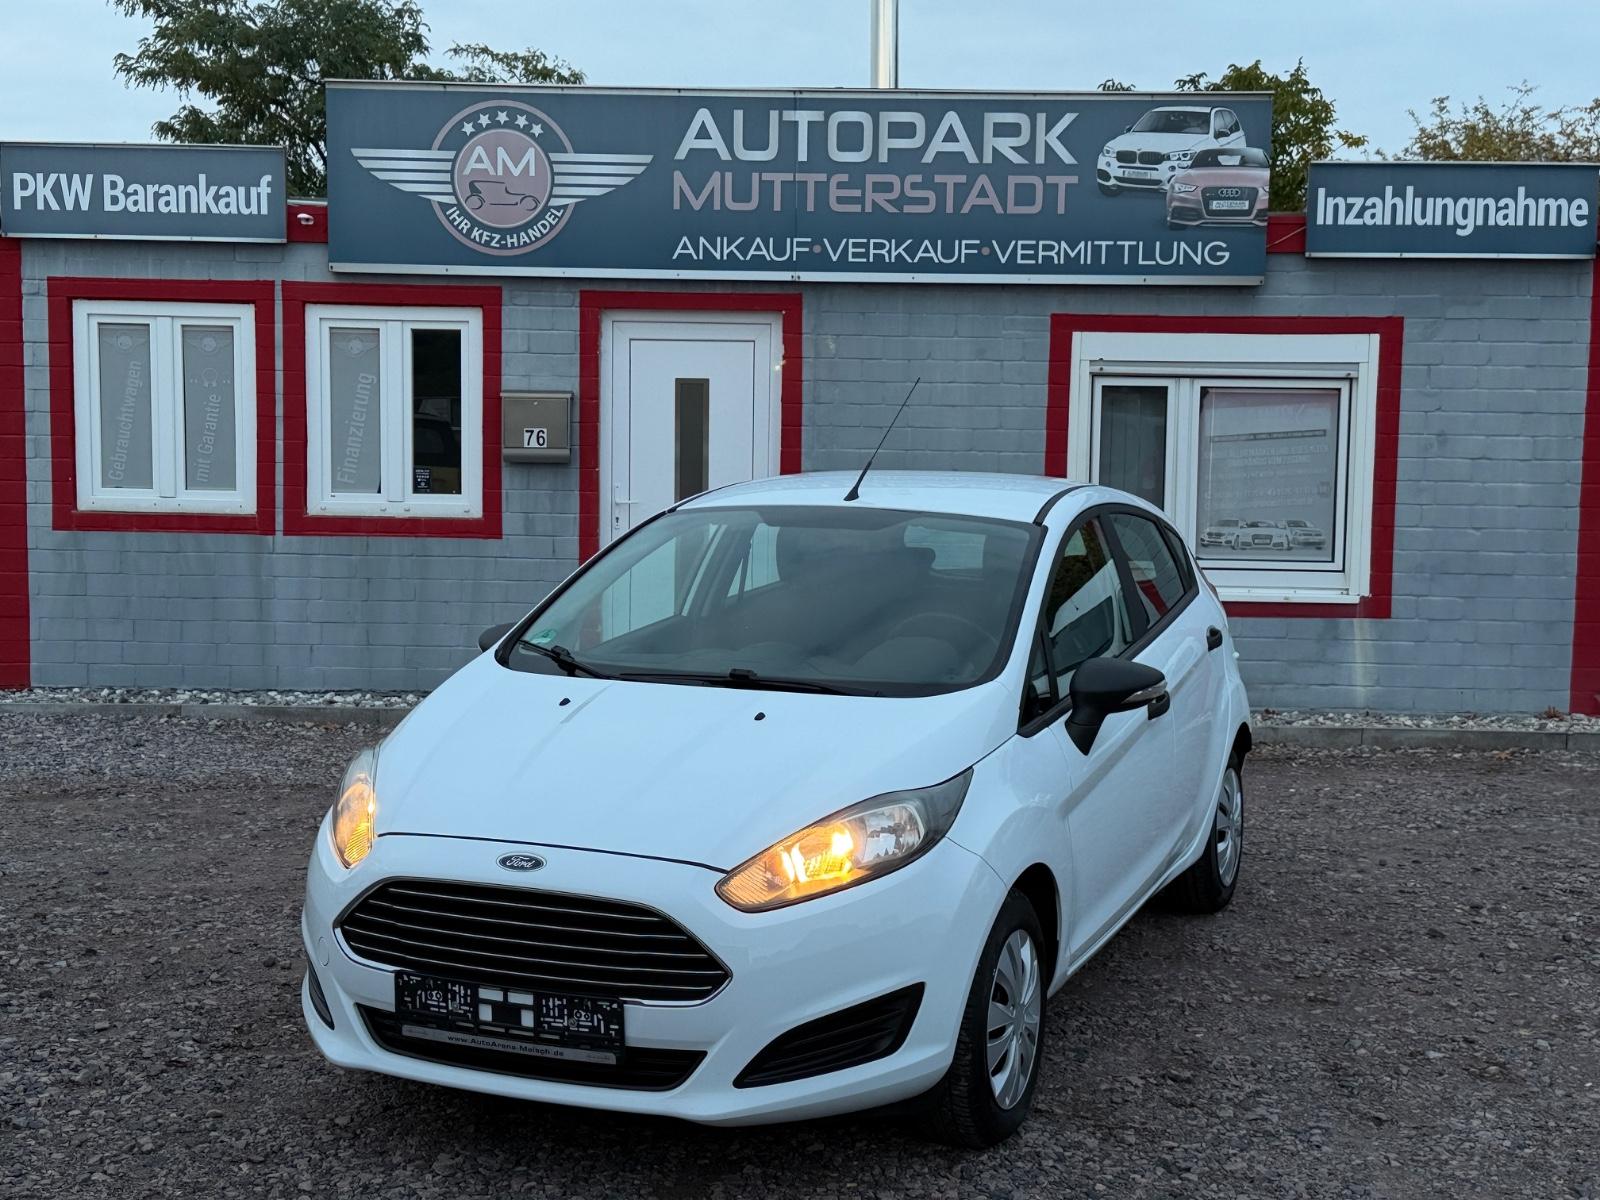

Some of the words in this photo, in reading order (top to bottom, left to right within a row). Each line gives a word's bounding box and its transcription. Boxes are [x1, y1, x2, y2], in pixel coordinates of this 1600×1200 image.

[674, 107, 1080, 165] AUTOPARK
[462, 145, 536, 177] AM
[13, 172, 94, 211] PKW
[103, 173, 272, 215] Barankauf
[673, 170, 1079, 215] MUTTERSTADT
[1316, 185, 1589, 237] Inzahlungnahme
[446, 206, 472, 234] IHR
[470, 207, 564, 248] KFZ-HANDEL
[672, 236, 812, 262] ANKAUF
[823, 238, 981, 264] VERKAUF
[991, 239, 1231, 266] VERMITTLUNG
[108, 360, 143, 481] Gebrauchtwagen
[198, 393, 222, 456] Garantie
[337, 372, 377, 484] Finanzierung
[525, 429, 546, 447] 76
[196, 457, 212, 482] mit
